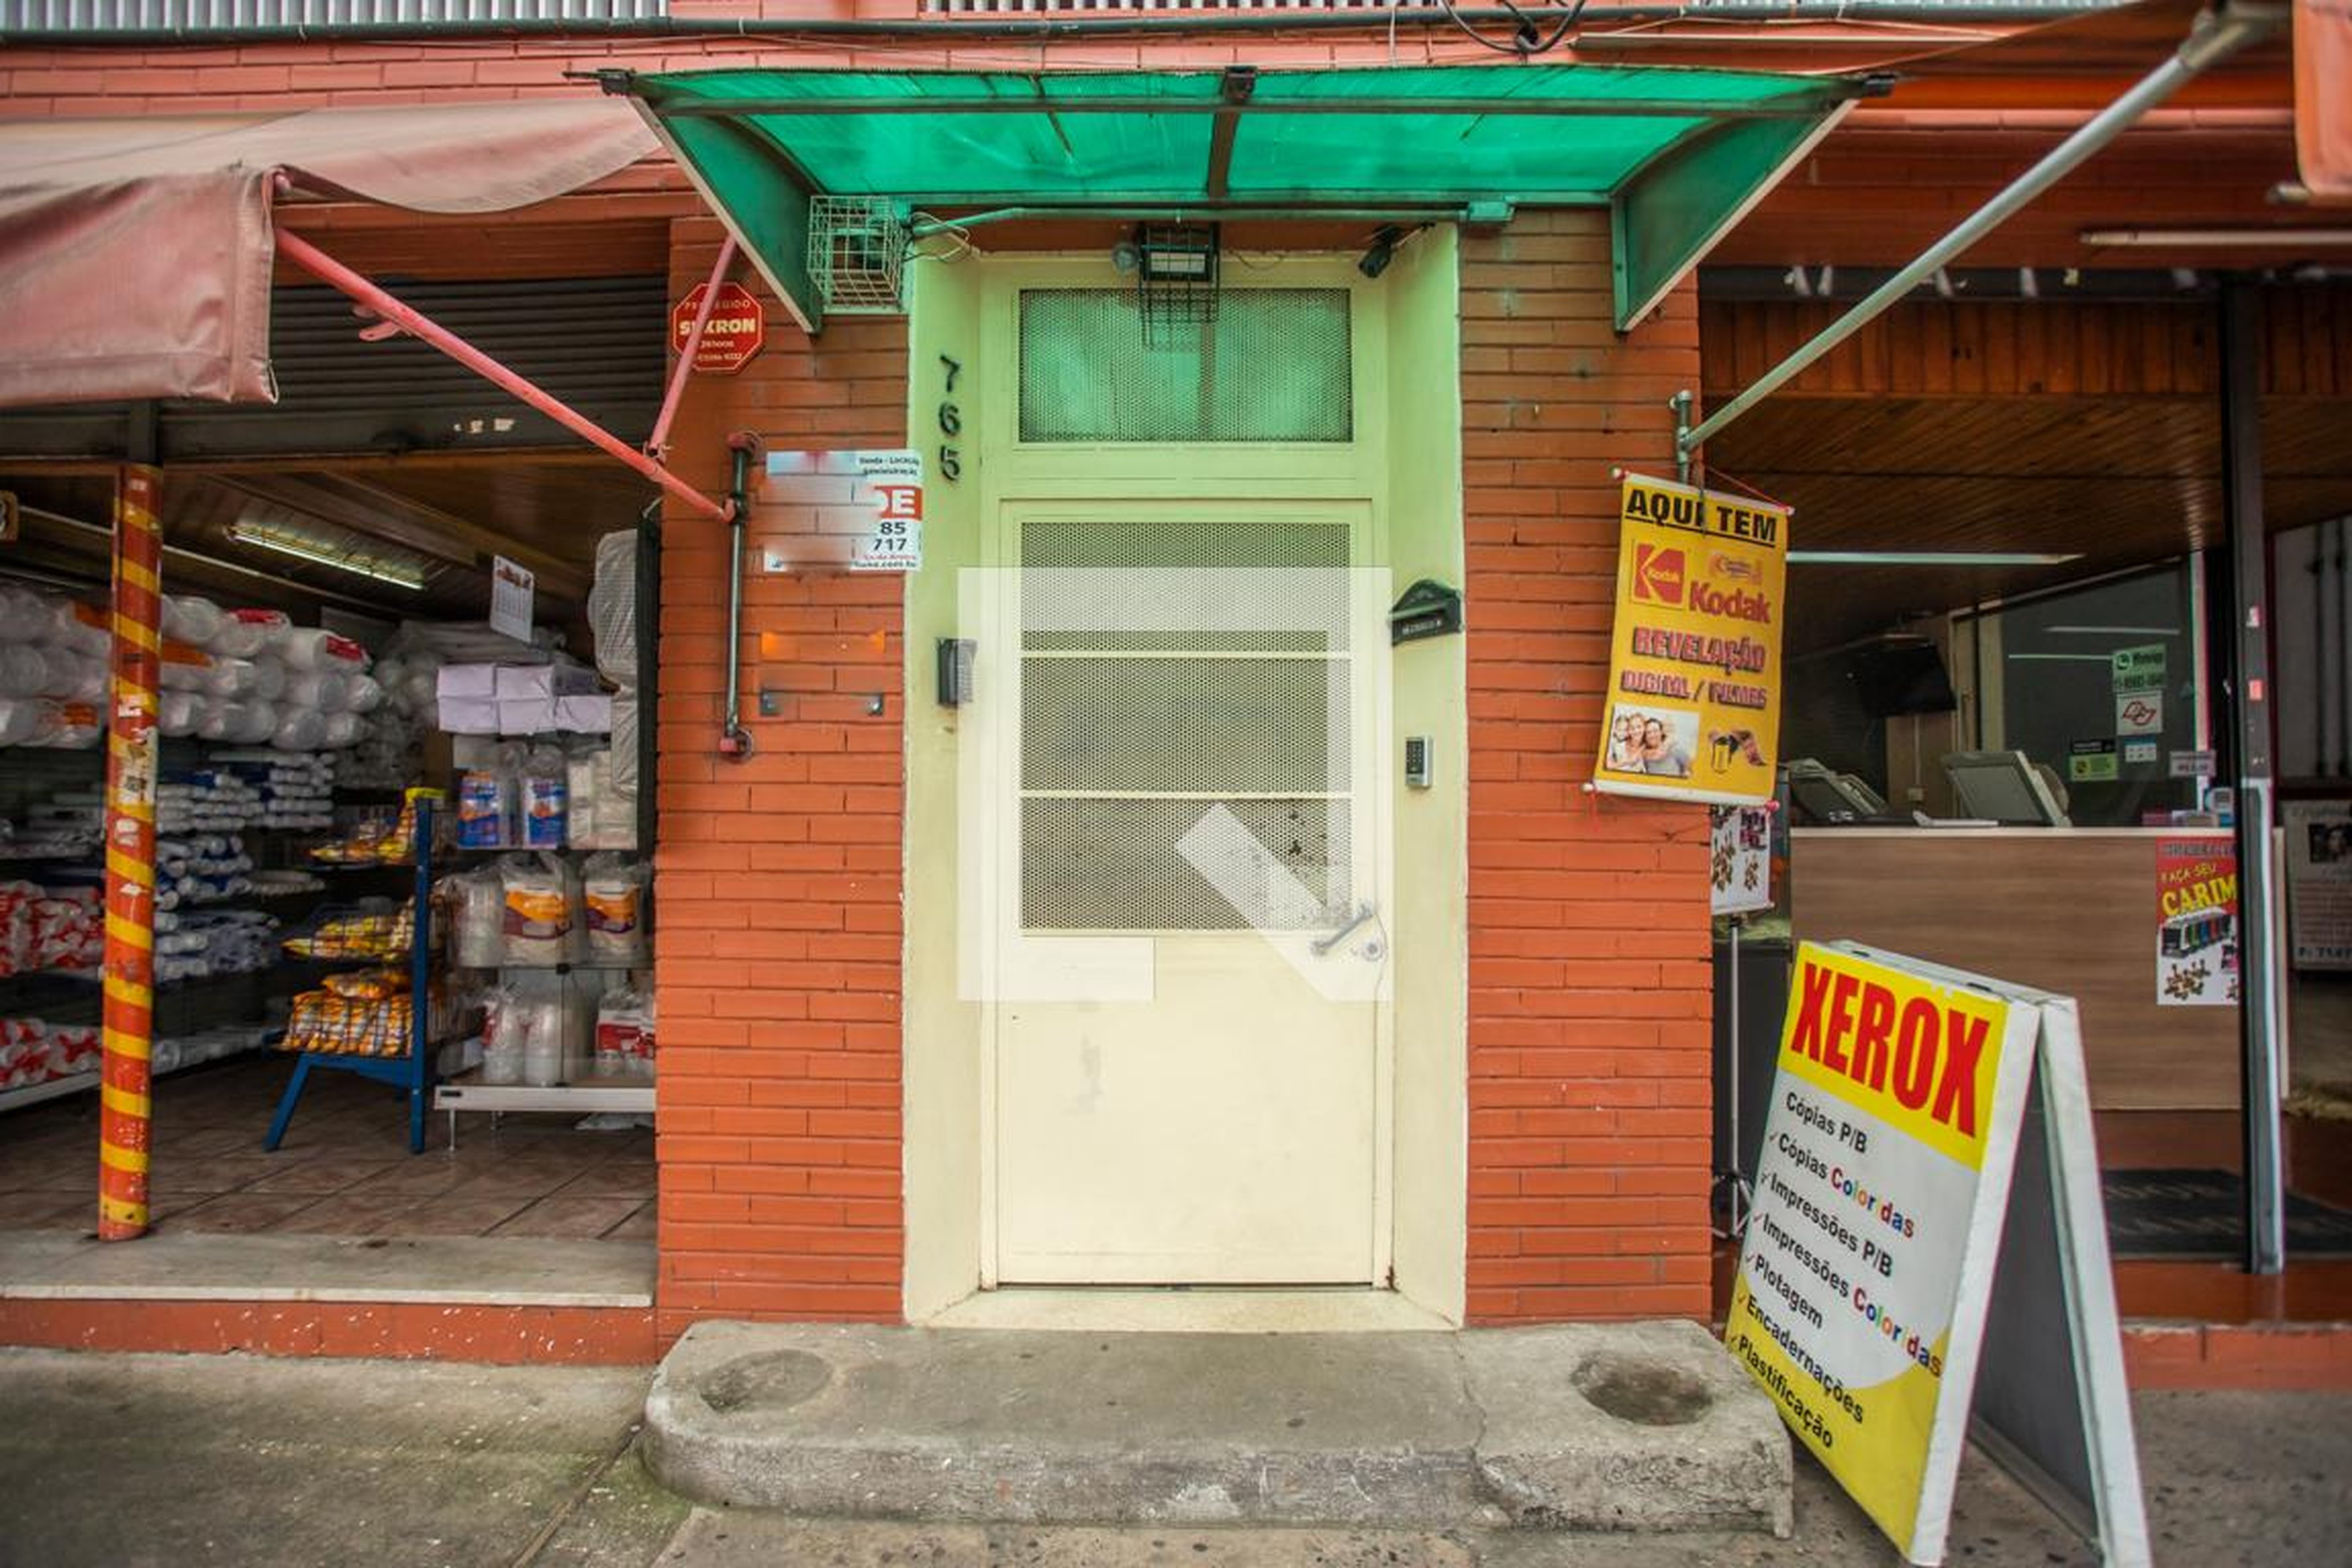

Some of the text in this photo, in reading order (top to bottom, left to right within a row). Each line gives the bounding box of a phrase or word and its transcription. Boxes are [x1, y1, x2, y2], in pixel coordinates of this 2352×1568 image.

[679, 318, 756, 336] SKRON
[939, 354, 962, 481] 765
[1627, 489, 1777, 542] AQUI TEM
[1690, 581, 1771, 624] Kodak
[1791, 962, 1991, 1139] XEROX
[1786, 1092, 1868, 1153] Cópias P/B
[1771, 1173, 1893, 1277] Impressões P/B
[1779, 1133, 1915, 1238] Cópias Coloridas
[1755, 1254, 1823, 1329] Plotagem
[1763, 1213, 1943, 1378] Impressões Coloridas
[1739, 1335, 1833, 1448] Plastificação
[1747, 1294, 1863, 1424] Encadernações
